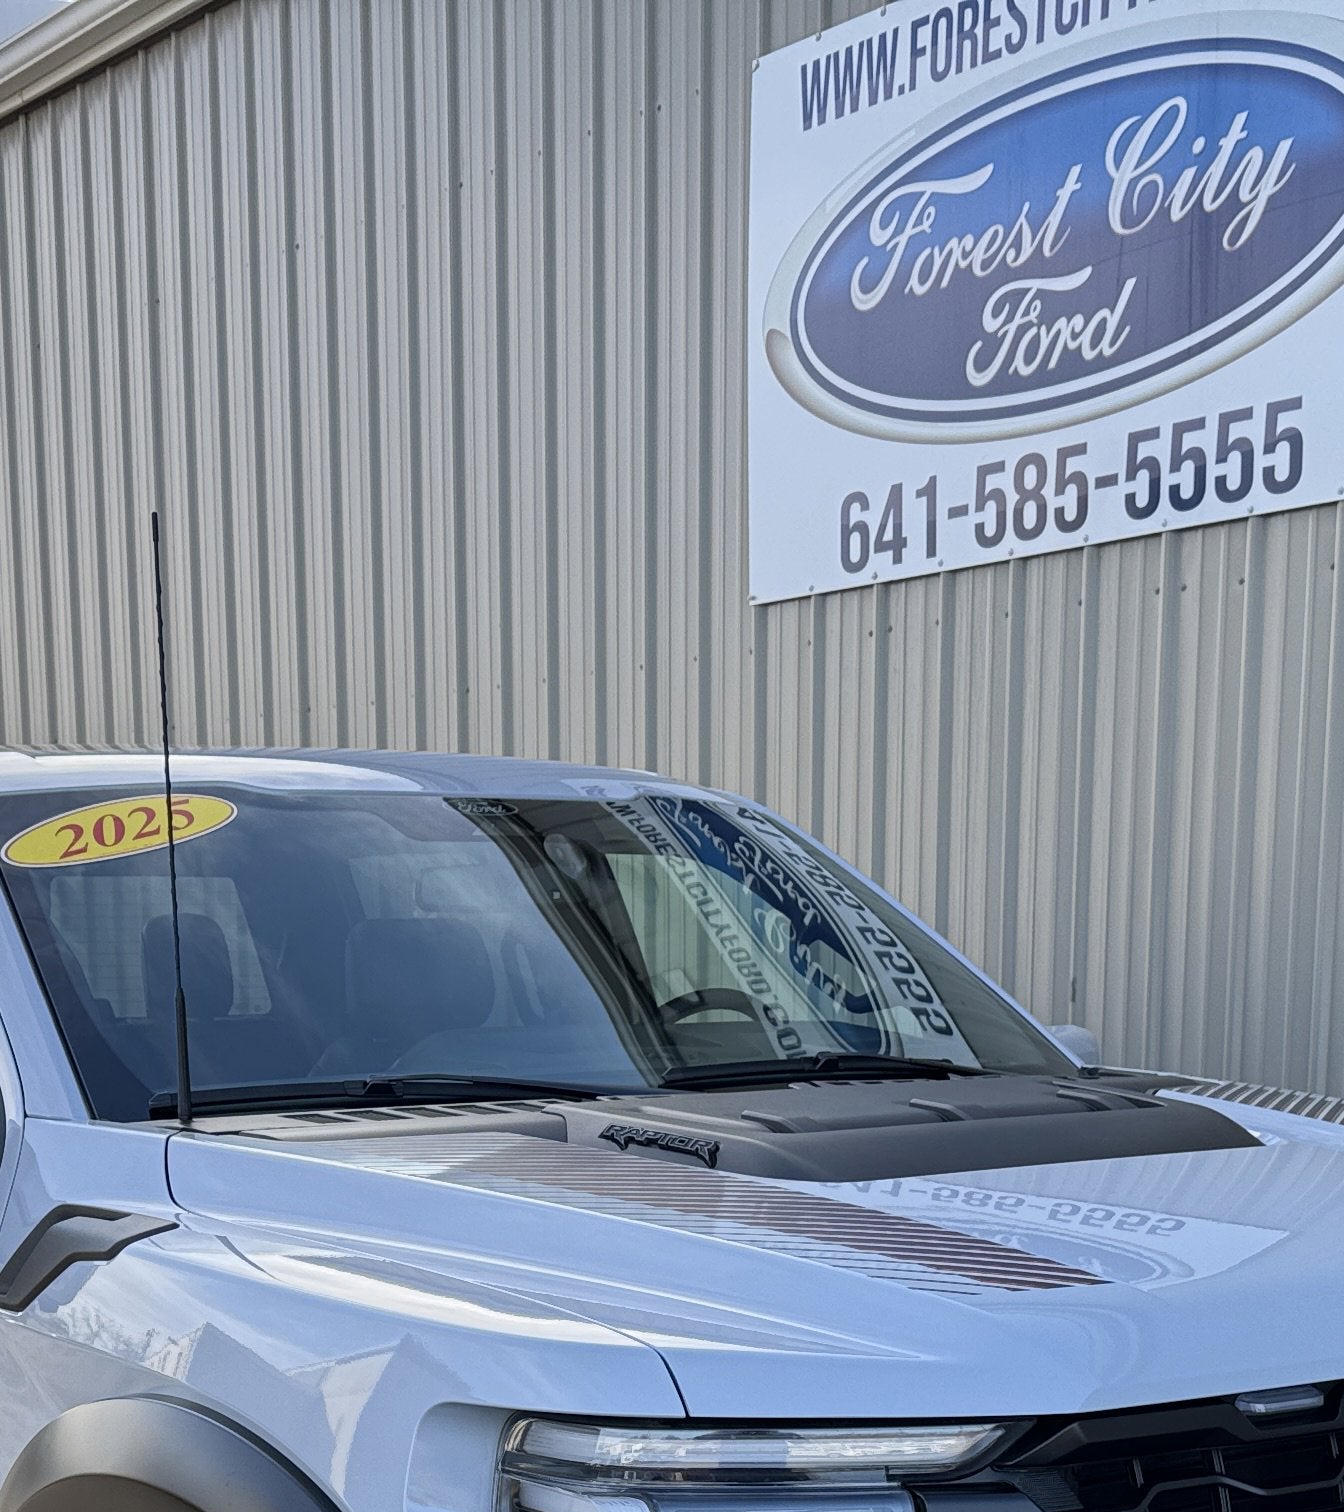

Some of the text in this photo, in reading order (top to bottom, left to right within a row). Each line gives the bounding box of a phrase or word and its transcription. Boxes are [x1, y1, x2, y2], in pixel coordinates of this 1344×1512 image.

[851, 96, 1296, 311] Forest City
[965, 265, 1138, 387] Ford
[839, 395, 1305, 575] 641-585-5555
[54, 799, 195, 860] 2025
[600, 1123, 721, 1168] RAPTOR
